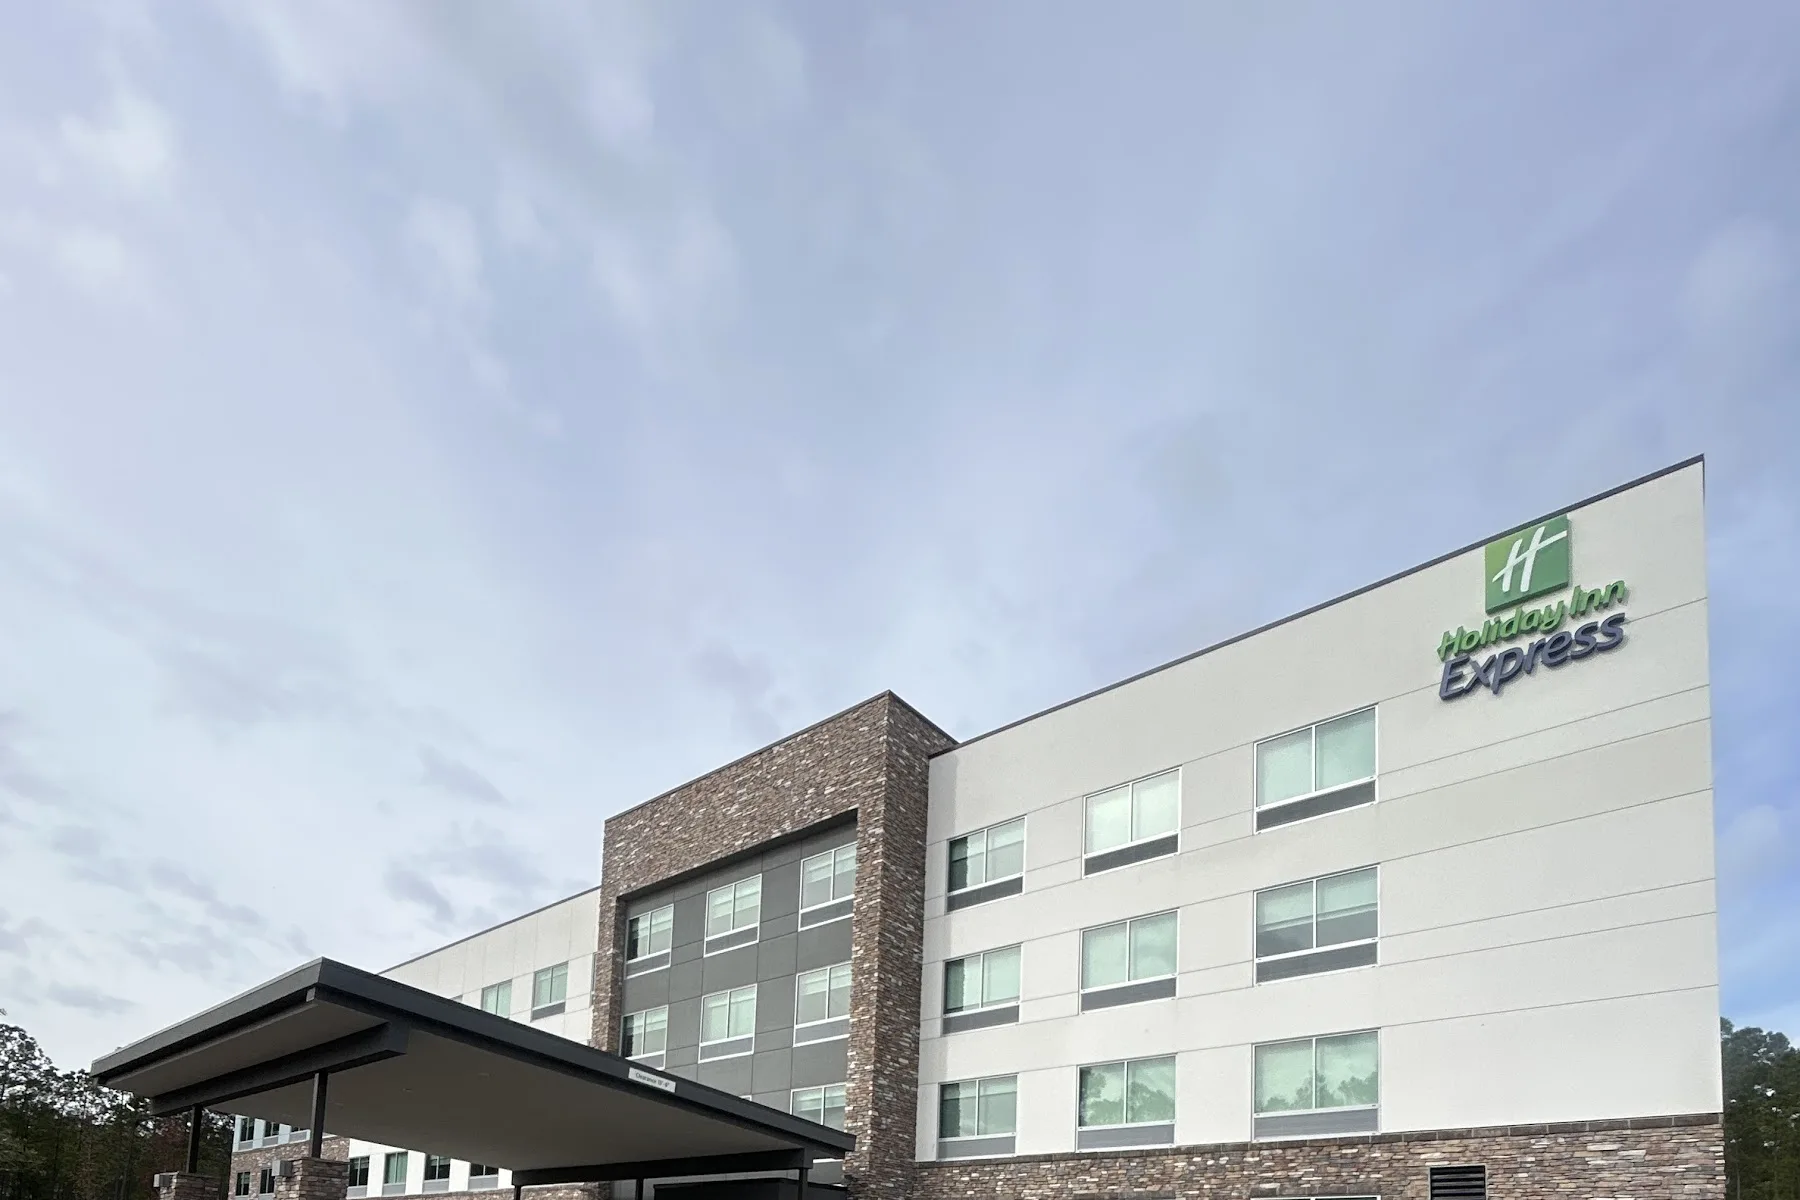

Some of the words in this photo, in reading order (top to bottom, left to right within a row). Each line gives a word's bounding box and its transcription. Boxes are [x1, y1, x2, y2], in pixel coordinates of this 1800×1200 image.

[1437, 600, 1564, 661] Holiday
[1569, 579, 1626, 618] Inn
[1439, 613, 1625, 700] Express
